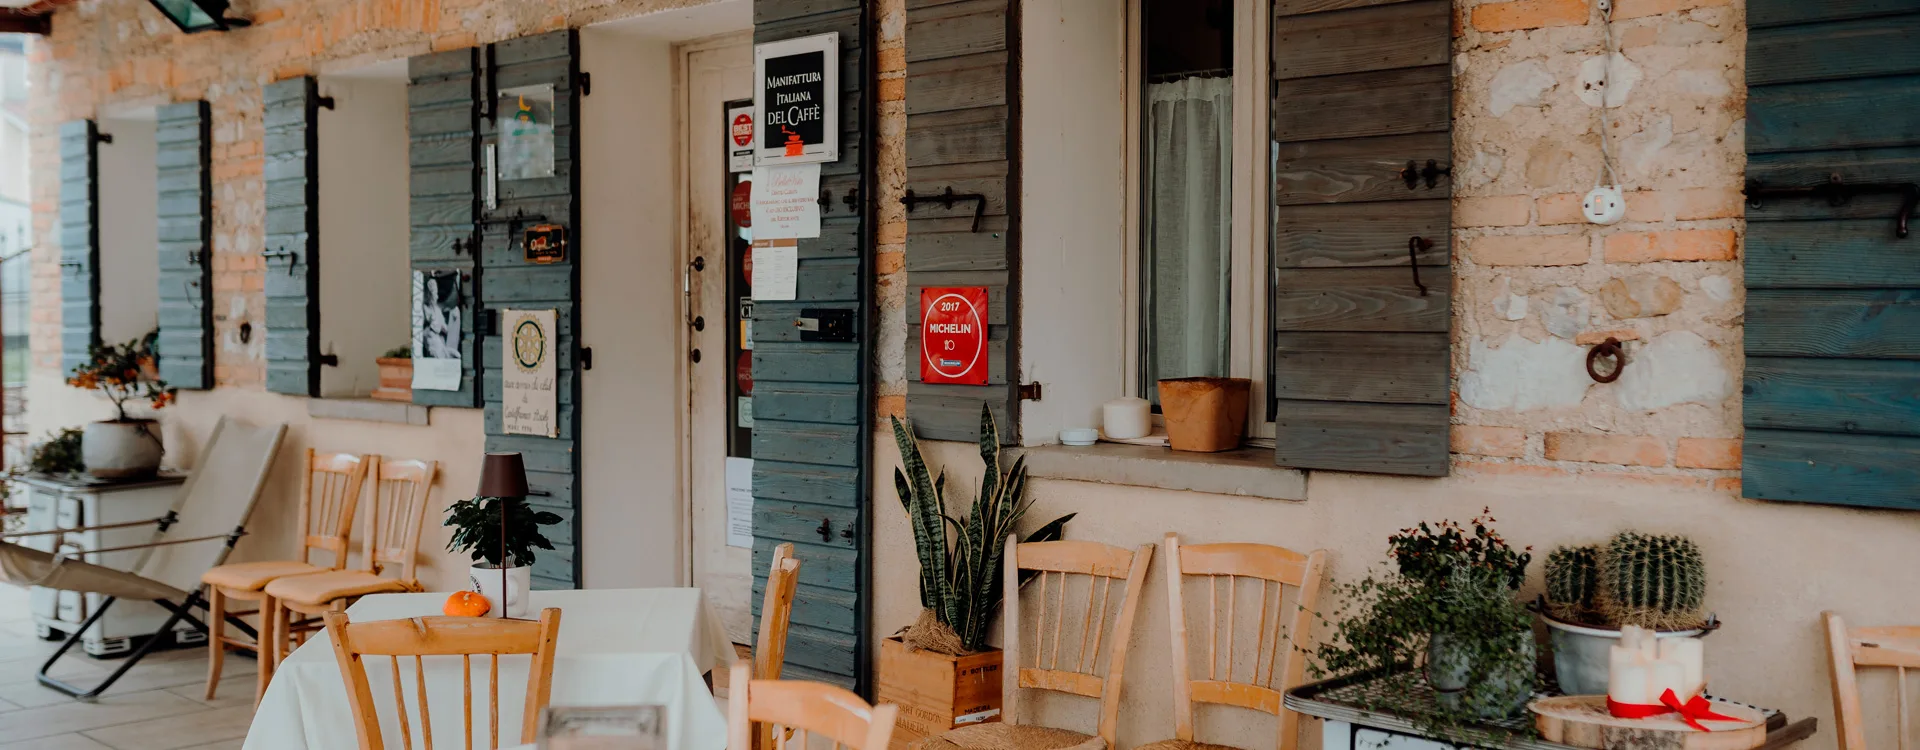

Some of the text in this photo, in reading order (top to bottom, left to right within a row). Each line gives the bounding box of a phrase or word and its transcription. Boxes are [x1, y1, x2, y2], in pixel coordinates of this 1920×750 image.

[767, 72, 821, 89] MANIFATTURA
[776, 91, 811, 106] ITALIANA
[768, 104, 820, 126] DEL CAFFÈ
[941, 302, 960, 311] 2017
[929, 324, 971, 334] MICHELIN
